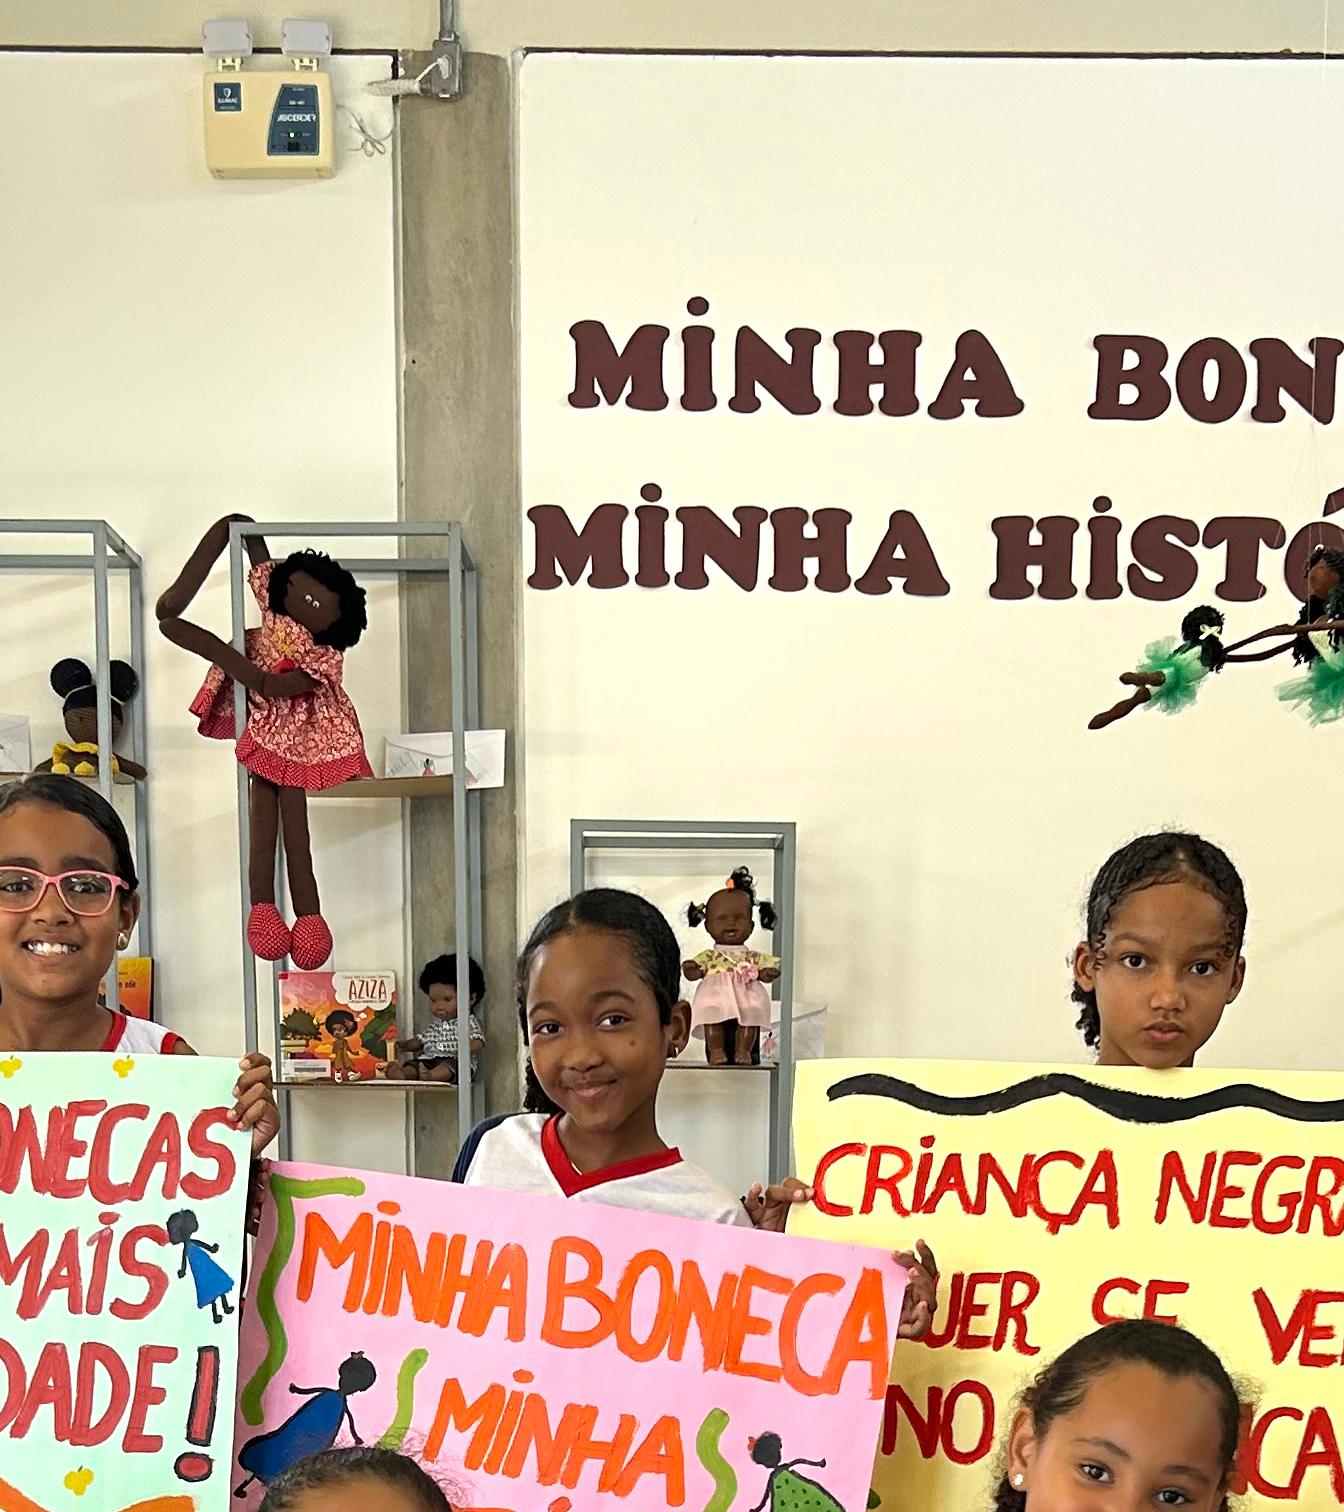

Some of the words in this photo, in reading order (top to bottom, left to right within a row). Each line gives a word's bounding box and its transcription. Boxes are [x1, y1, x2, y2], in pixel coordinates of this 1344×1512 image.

[349, 979, 387, 1000] AZIZA
[538, 1235, 890, 1401] BONECA
[897, 1270, 1042, 1356] UER
[881, 1379, 995, 1465] NO
